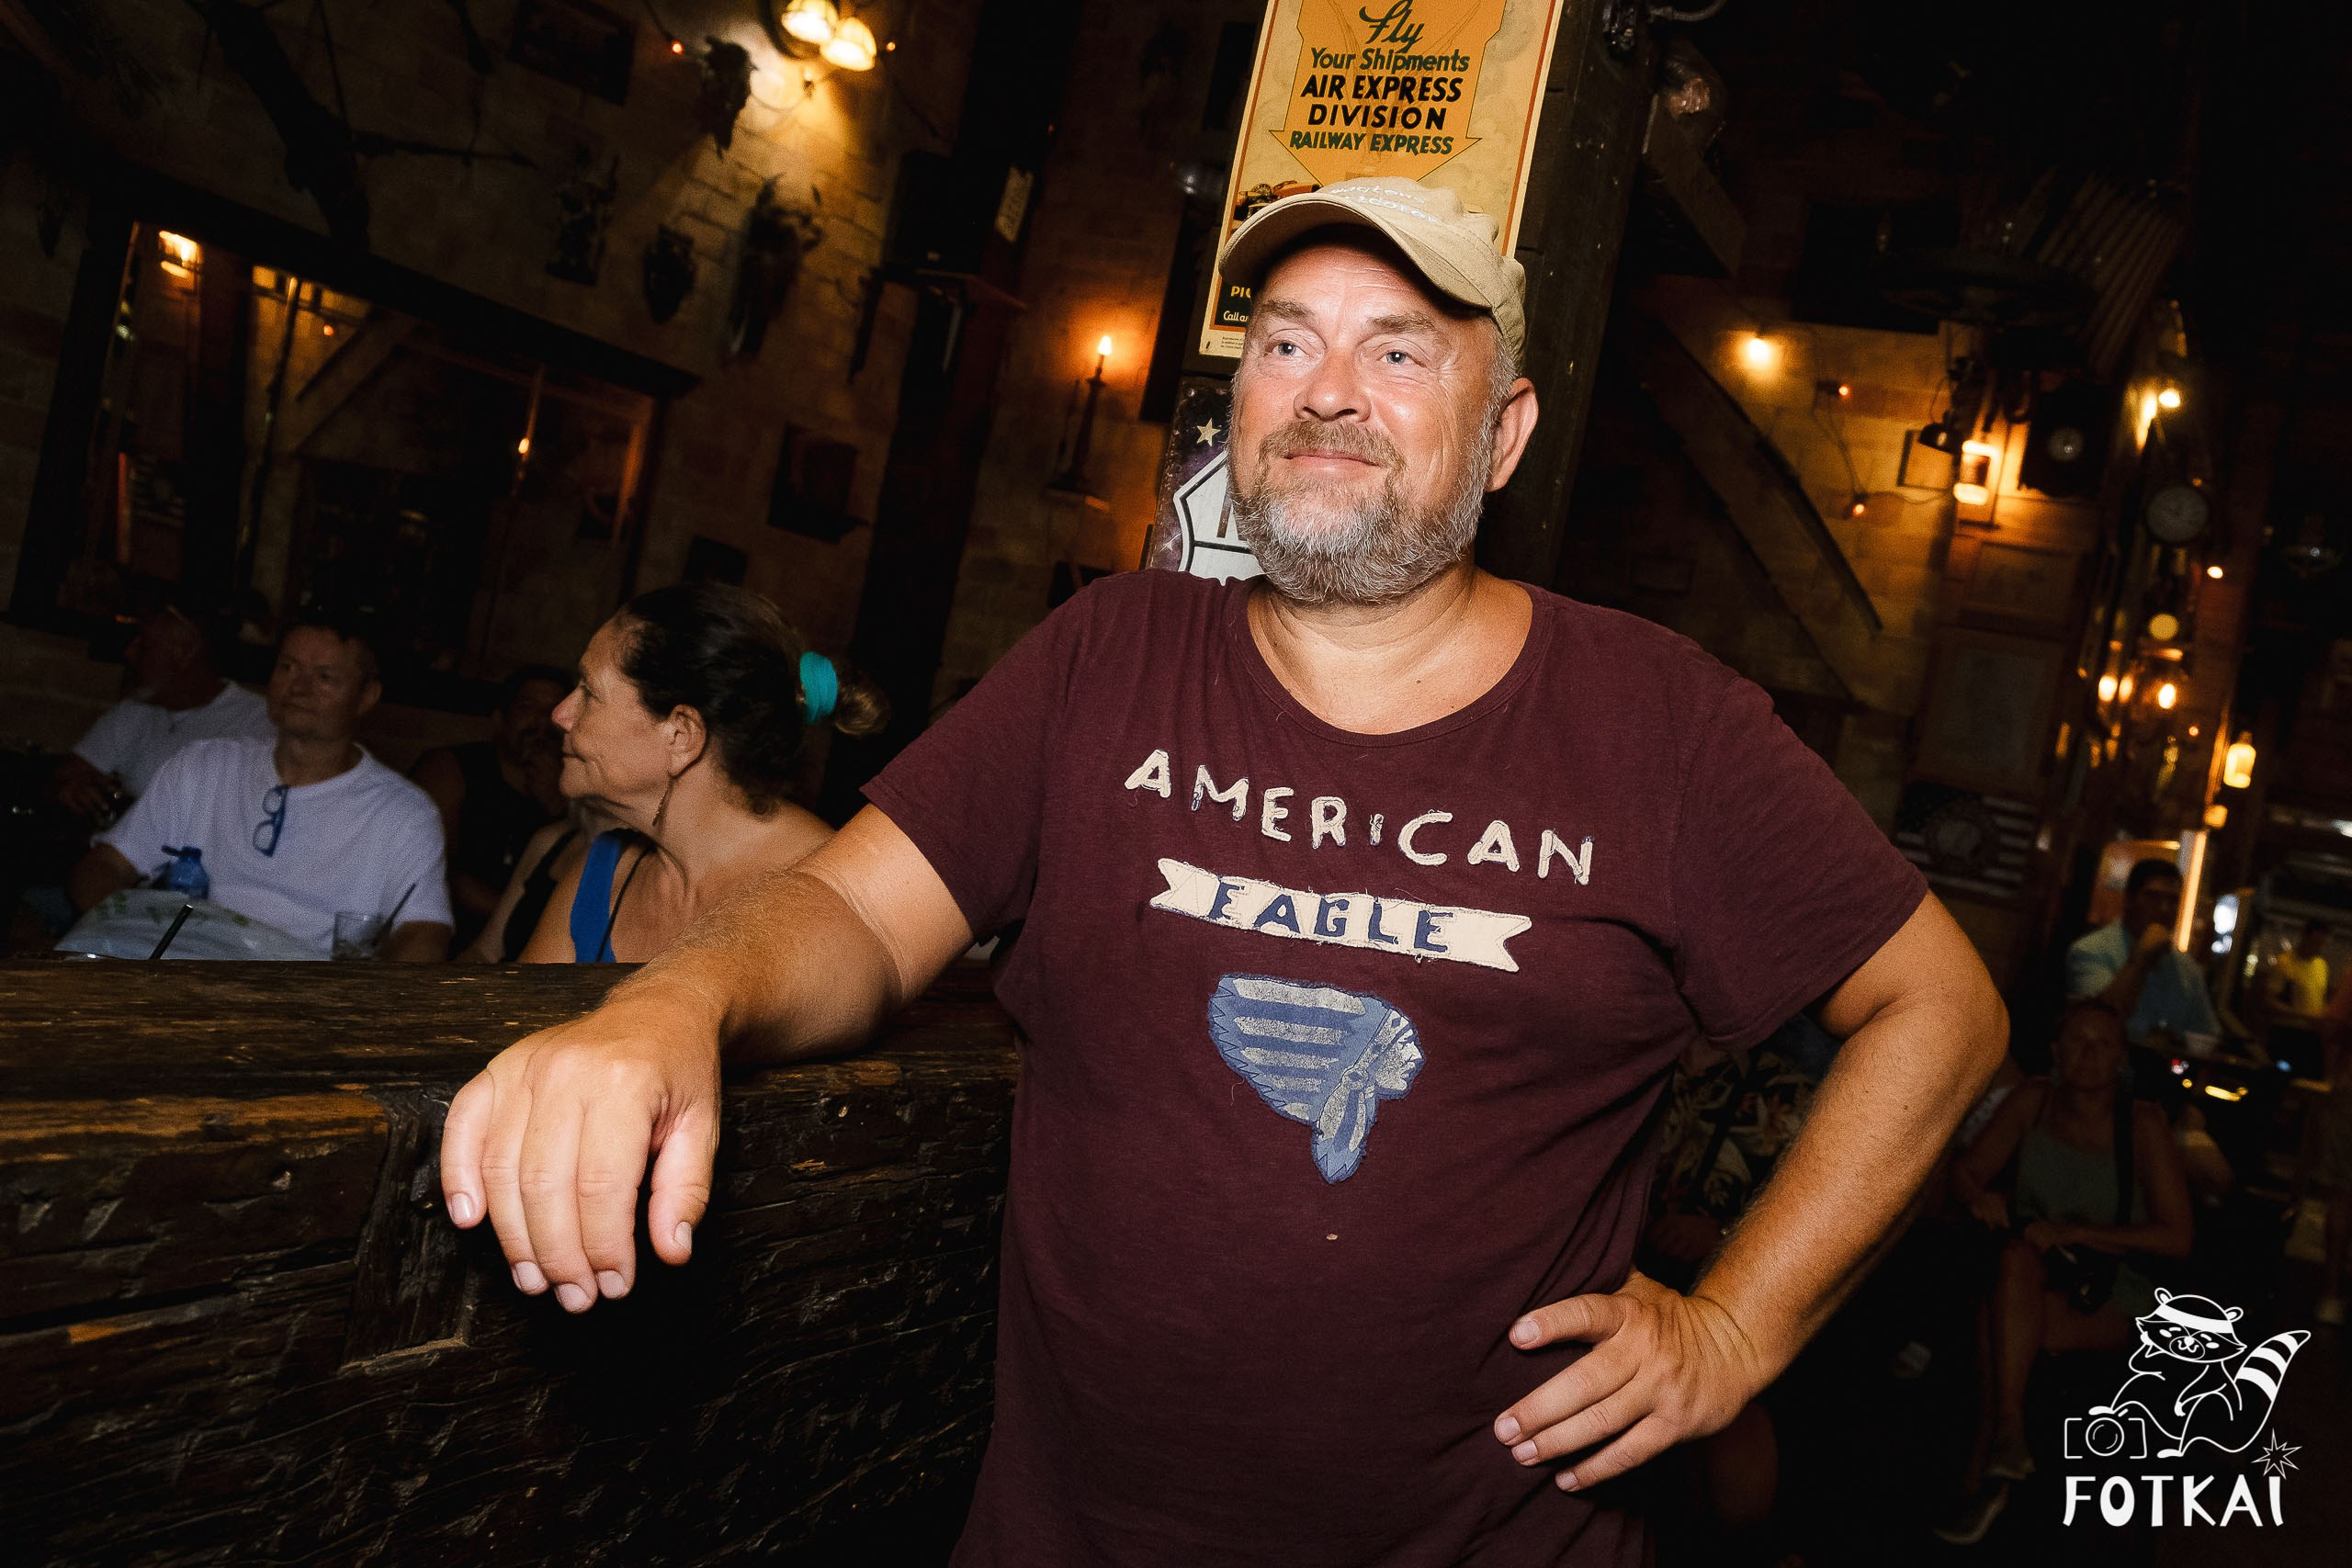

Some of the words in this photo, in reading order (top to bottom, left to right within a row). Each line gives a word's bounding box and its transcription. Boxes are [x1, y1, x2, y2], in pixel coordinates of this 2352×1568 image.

[1310, 47, 1356, 70] Your
[1359, 48, 1471, 74] Shipments
[1300, 74, 1346, 101] AIR
[1351, 74, 1464, 104] EXPRESS
[1307, 104, 1447, 130] DIVISION
[1289, 130, 1367, 151] RAILWAY
[1370, 133, 1454, 156] EXPRESS
[1223, 310, 1239, 321] Call
[1124, 750, 1594, 886] AMERICAN
[1208, 880, 1453, 953] EAGLE
